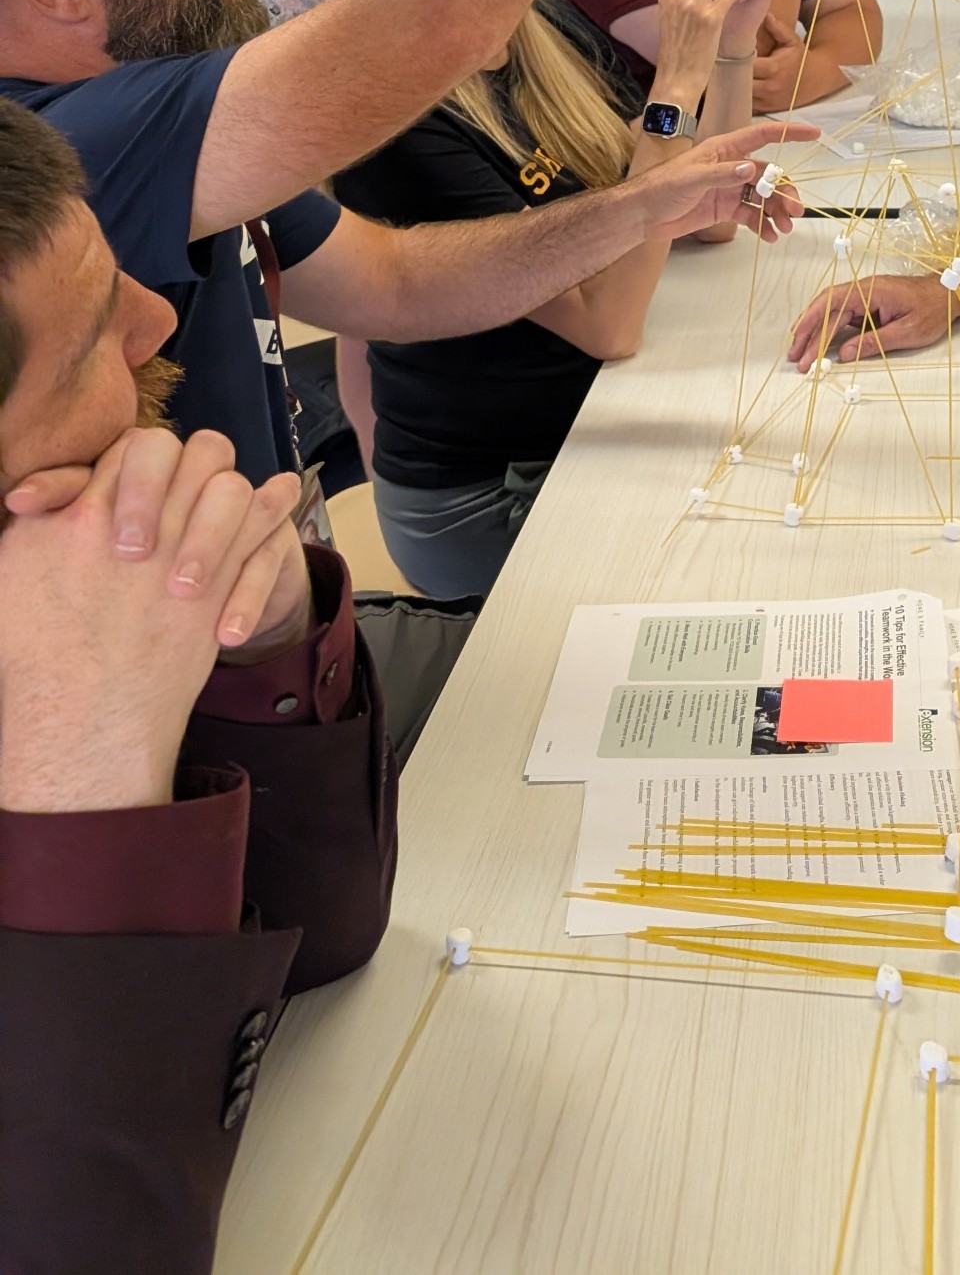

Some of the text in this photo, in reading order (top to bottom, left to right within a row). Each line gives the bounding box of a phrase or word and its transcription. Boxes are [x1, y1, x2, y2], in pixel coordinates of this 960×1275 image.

[882, 607, 892, 644] Teamwork
[894, 605, 906, 676] 10 Tips for Effective
[883, 654, 892, 665] the
[919, 709, 936, 752] extension
